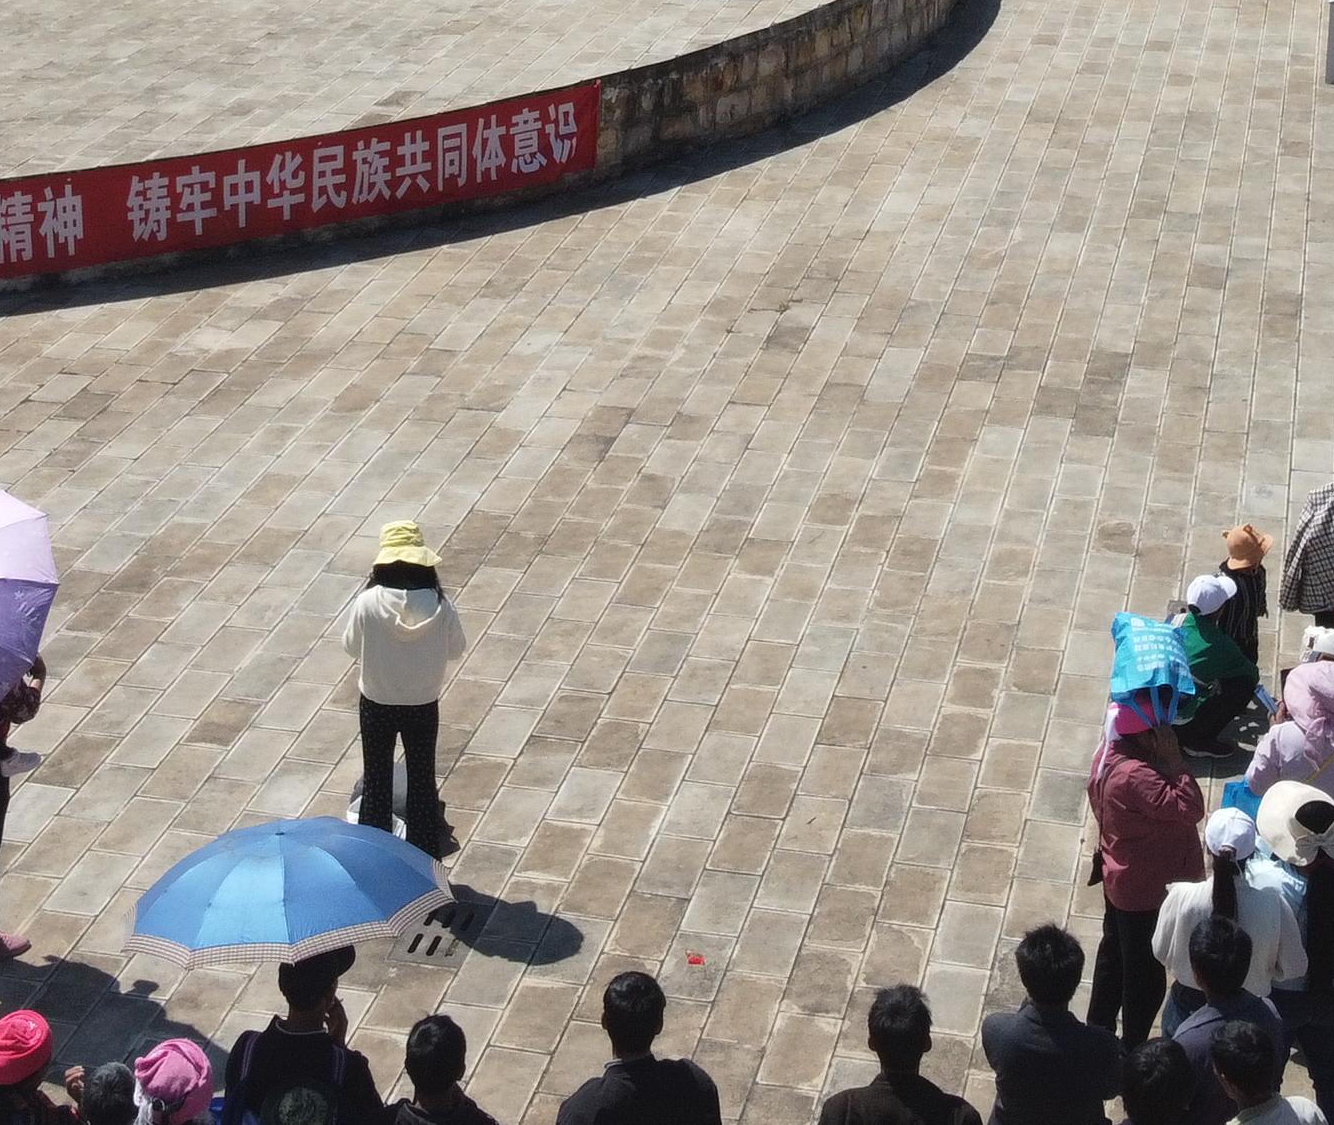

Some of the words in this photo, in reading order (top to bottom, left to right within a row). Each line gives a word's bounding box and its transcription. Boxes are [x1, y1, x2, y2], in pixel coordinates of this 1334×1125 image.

[127, 101, 578, 242] 铸牢中华民族共同体意识
